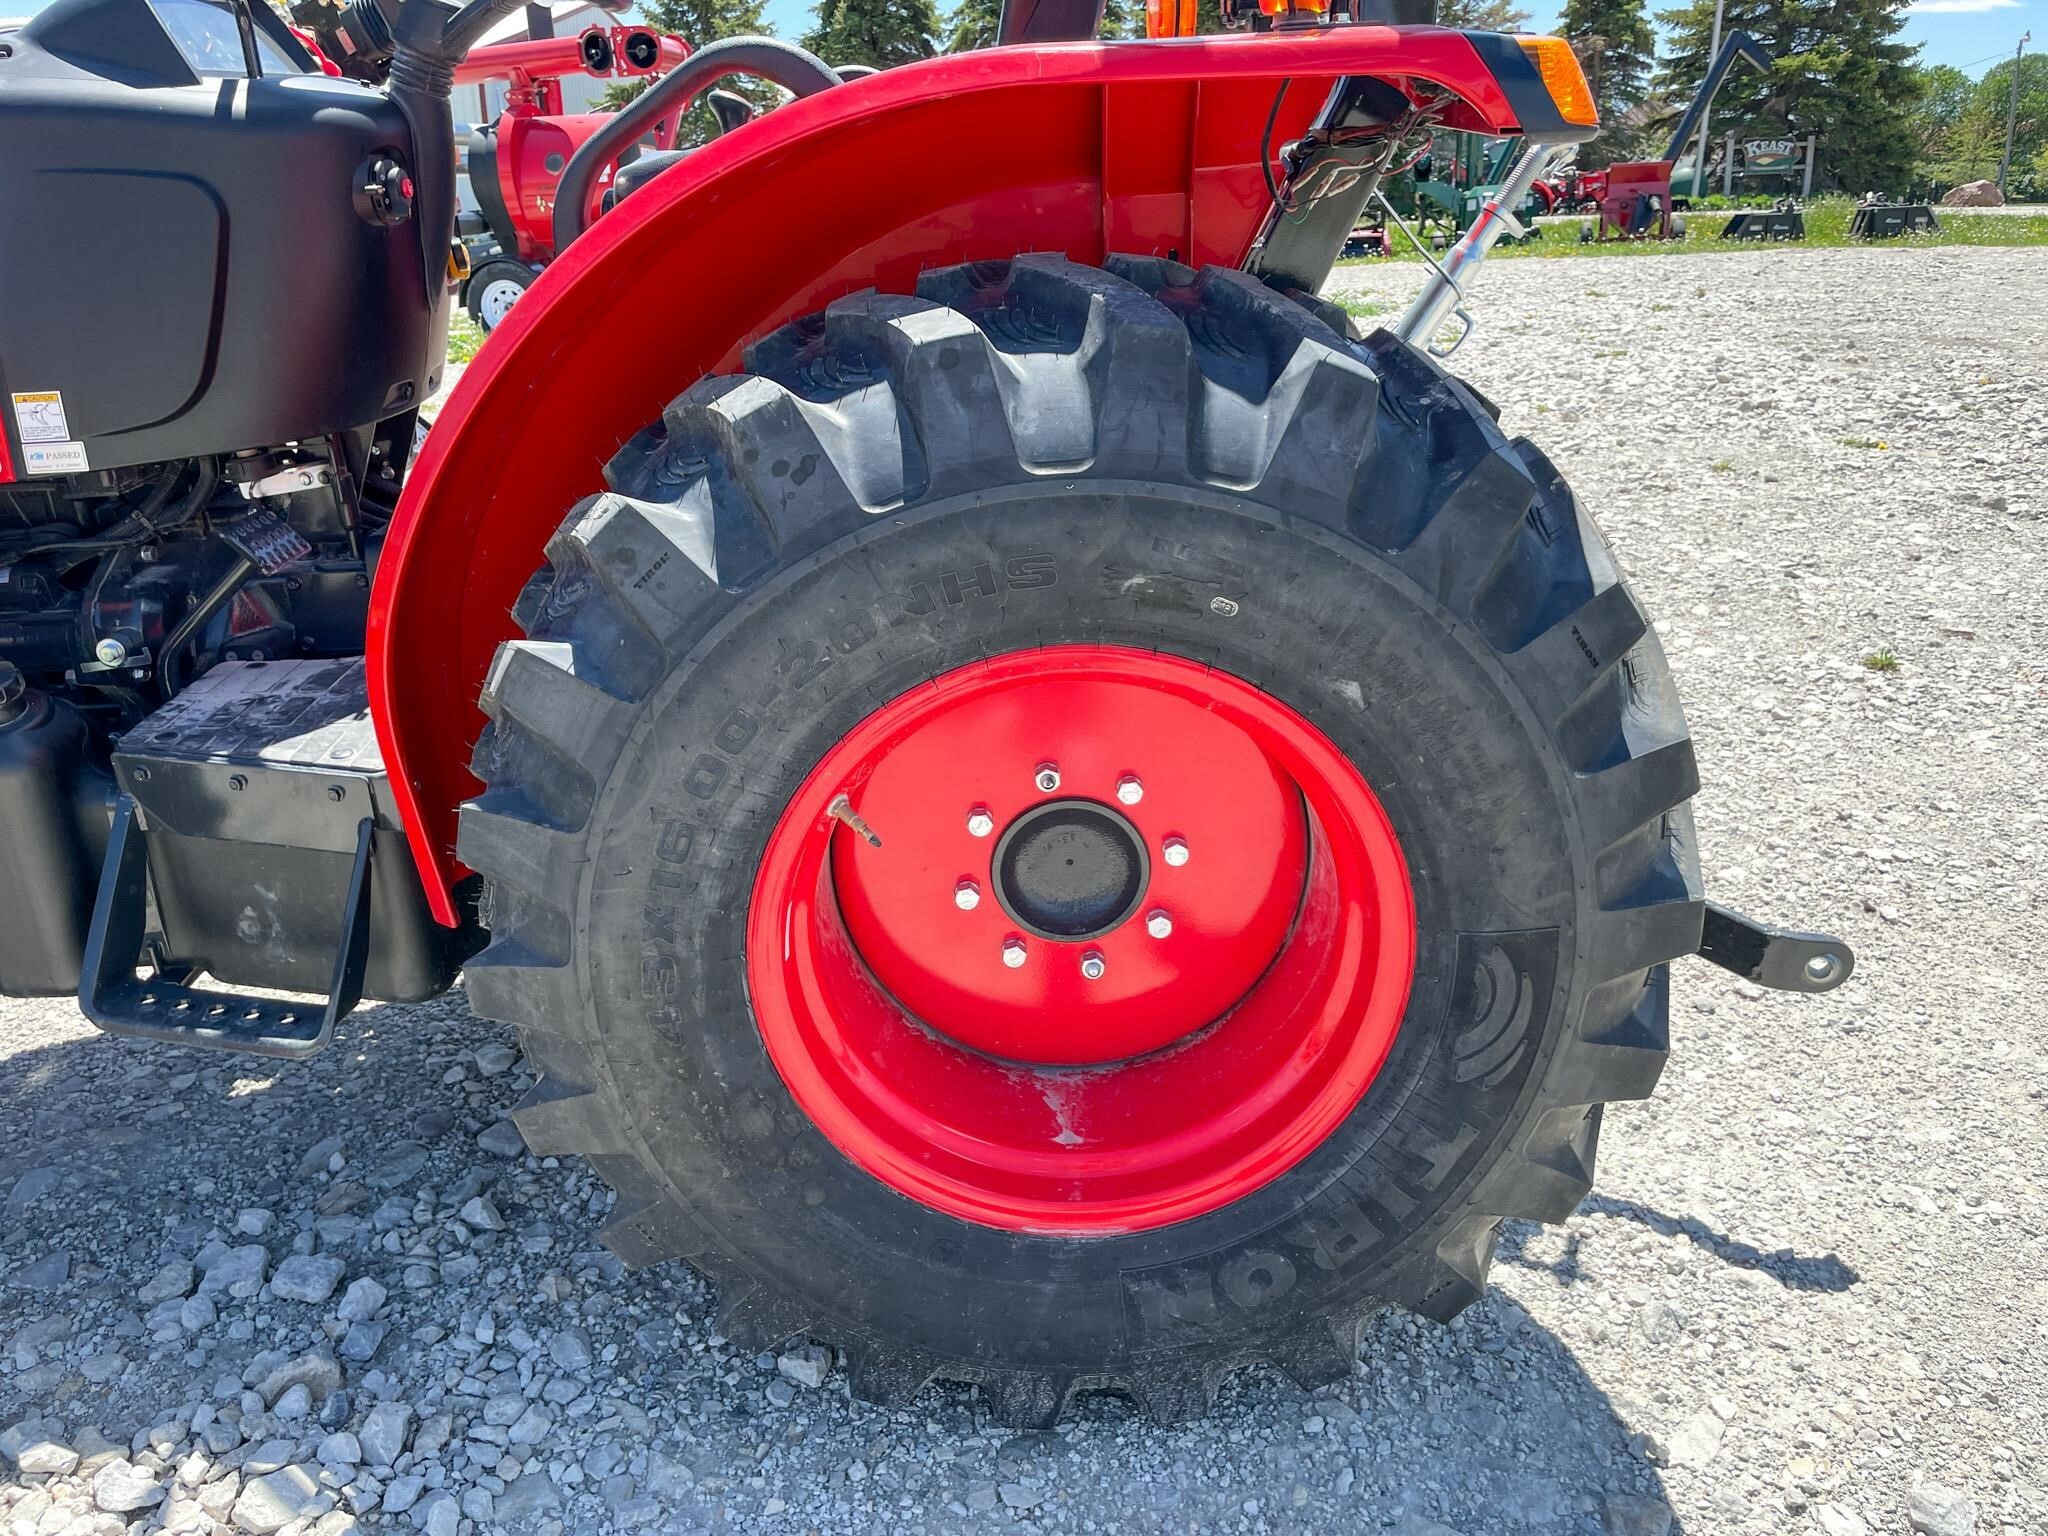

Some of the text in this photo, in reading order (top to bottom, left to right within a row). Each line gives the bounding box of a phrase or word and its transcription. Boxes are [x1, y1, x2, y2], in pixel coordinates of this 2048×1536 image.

[1744, 140, 1795, 158] KEAST
[45, 450, 81, 460] PASSED
[1134, 1121, 1481, 1338] TIRON
